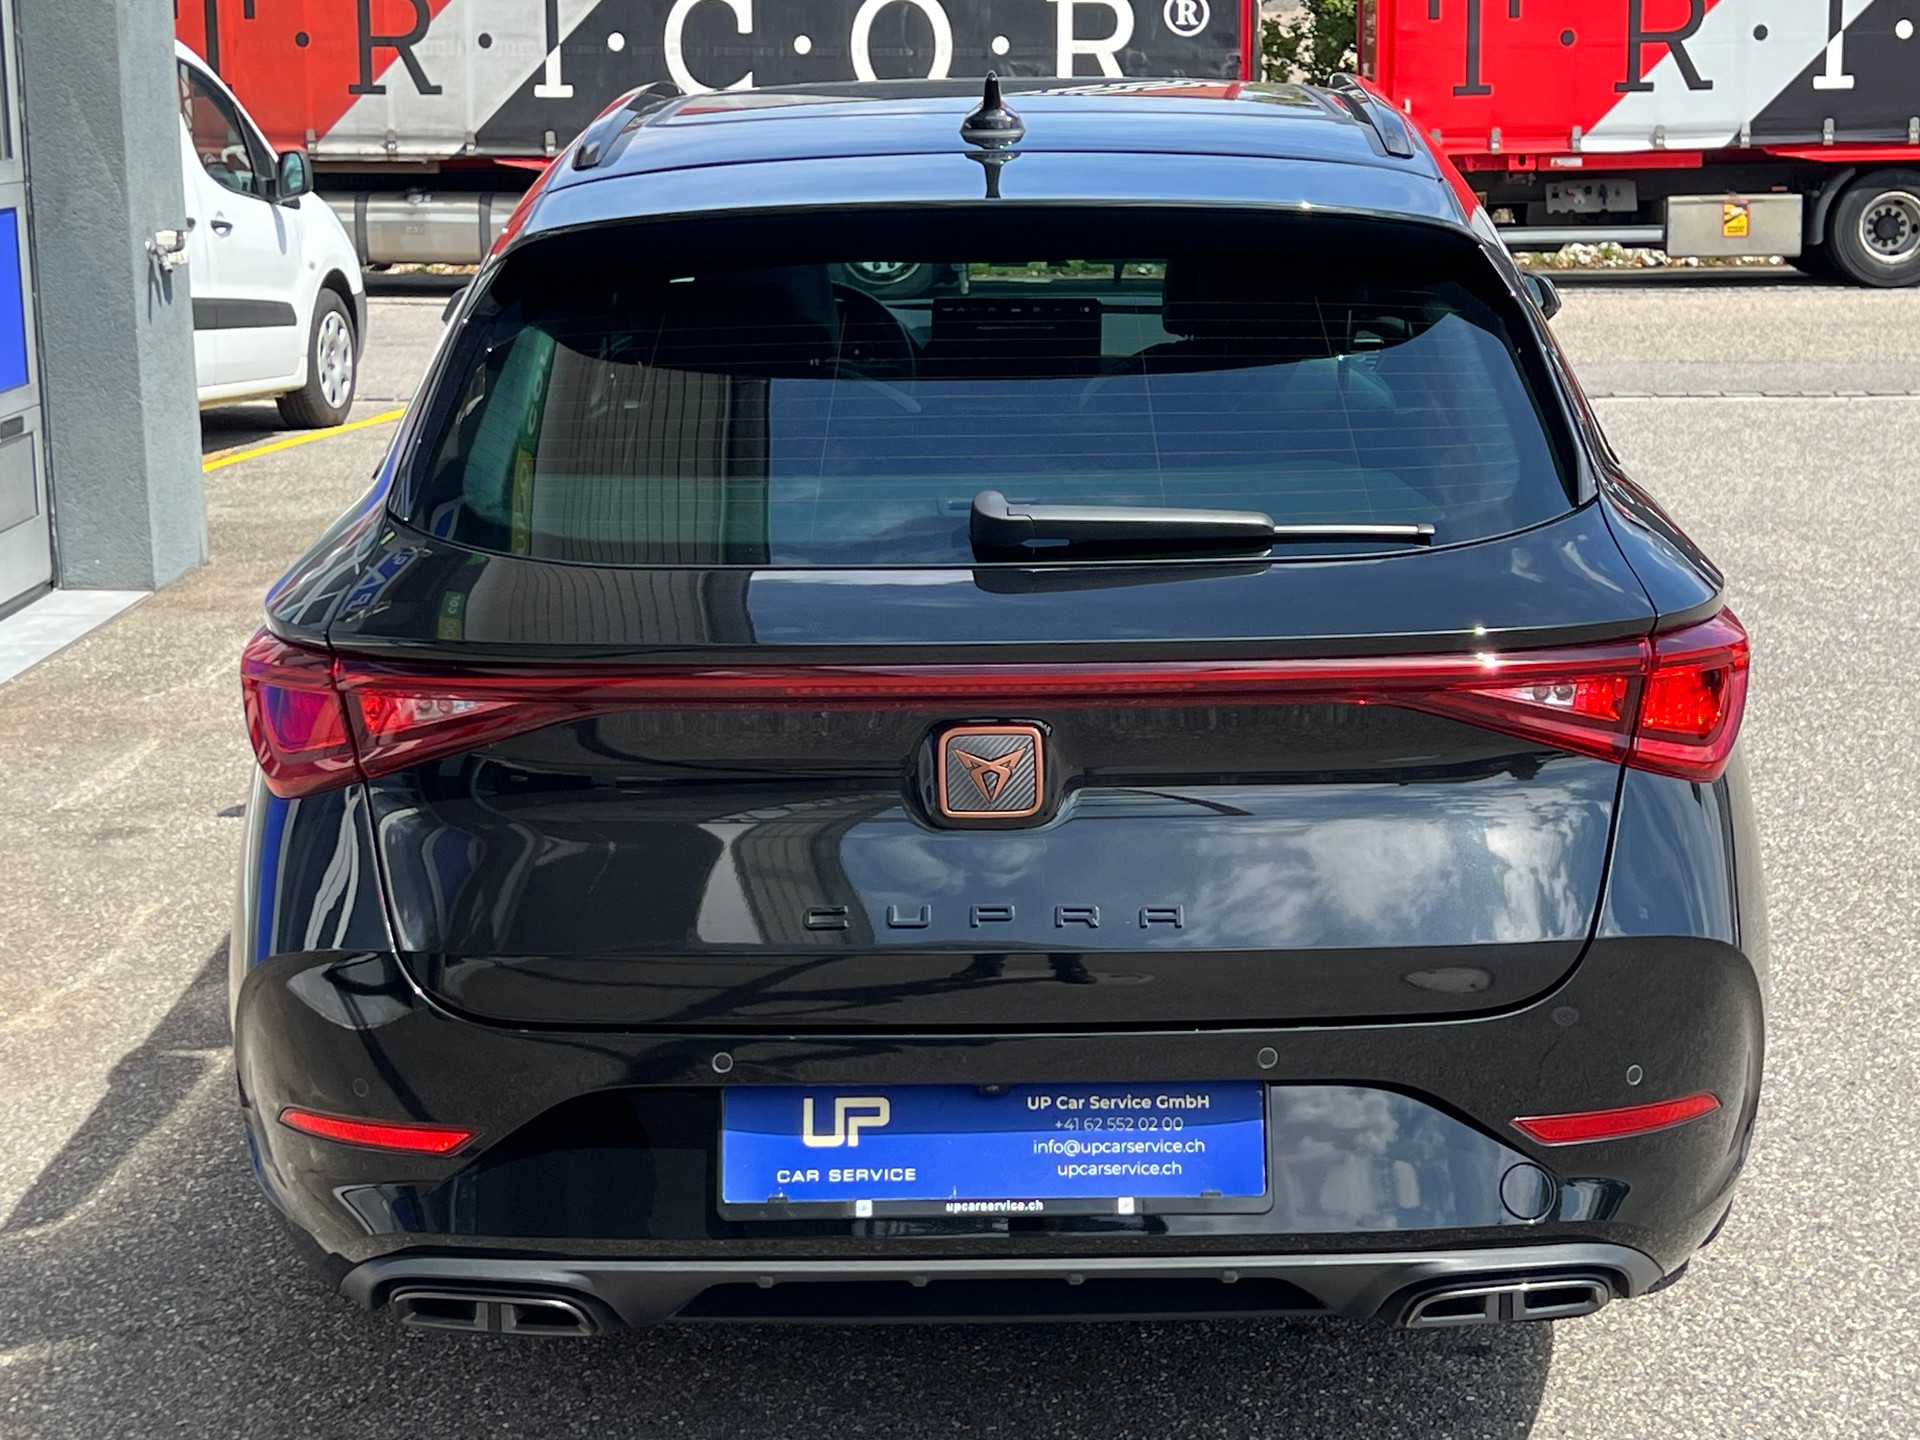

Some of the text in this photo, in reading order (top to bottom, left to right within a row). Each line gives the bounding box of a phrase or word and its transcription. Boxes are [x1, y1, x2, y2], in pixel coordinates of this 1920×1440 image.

[803, 904, 1185, 930] CUPRA
[1026, 1094, 1210, 1110] UP Car Service GmbH
[802, 1096, 891, 1147] UP
[1055, 1116, 1184, 1131] +41 62 552 02 00
[1032, 1138, 1206, 1157] info@upcarservice.ch
[776, 1168, 917, 1183] CAR SERVICE
[1057, 1160, 1183, 1178] upcarservice.ch
[945, 1200, 1044, 1214] upcarservice.ch
